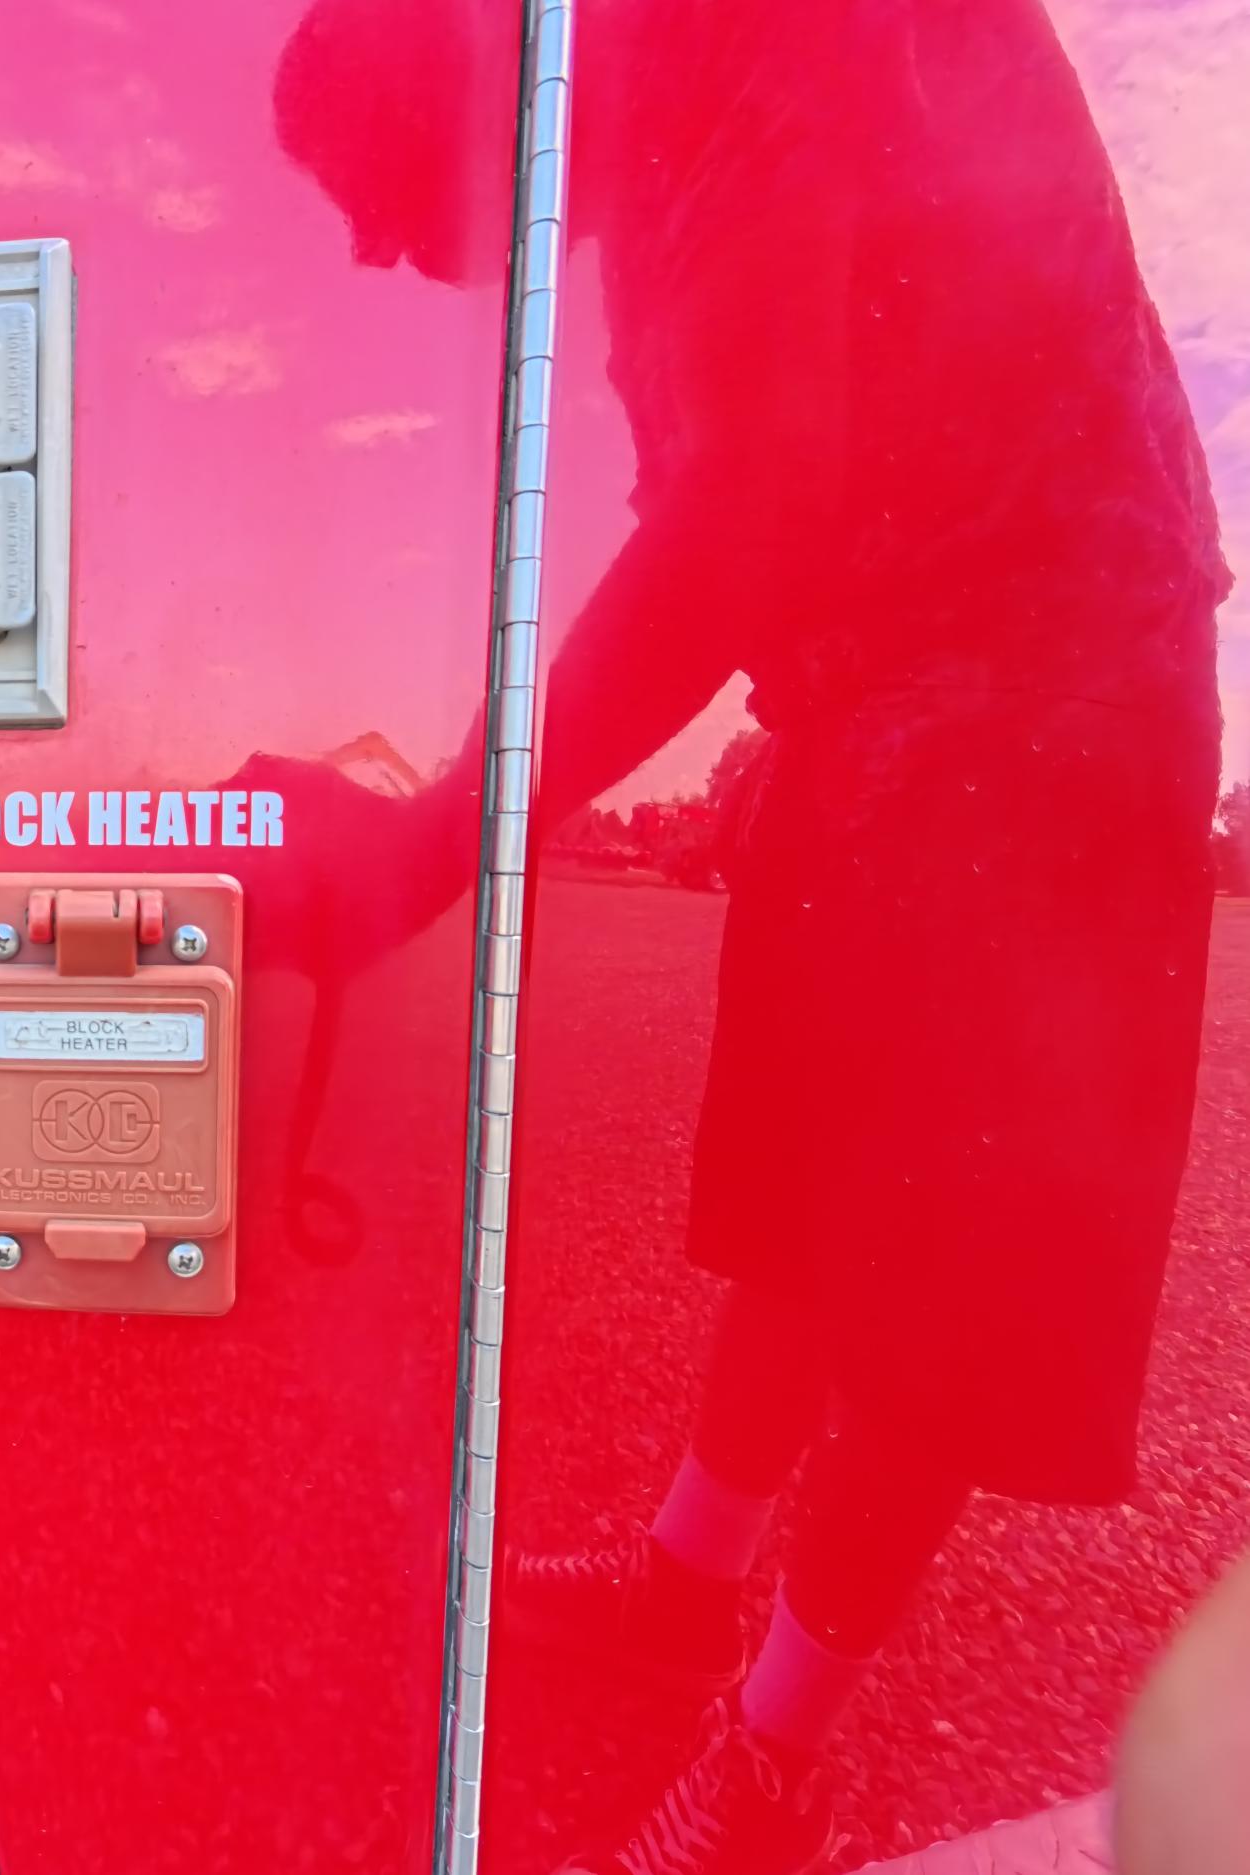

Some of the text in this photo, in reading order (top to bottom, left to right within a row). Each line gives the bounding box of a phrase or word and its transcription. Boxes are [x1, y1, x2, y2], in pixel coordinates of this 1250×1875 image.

[88, 791, 284, 846] HEATER
[66, 1020, 125, 1034] BLOCK
[61, 1038, 128, 1051] HEATER
